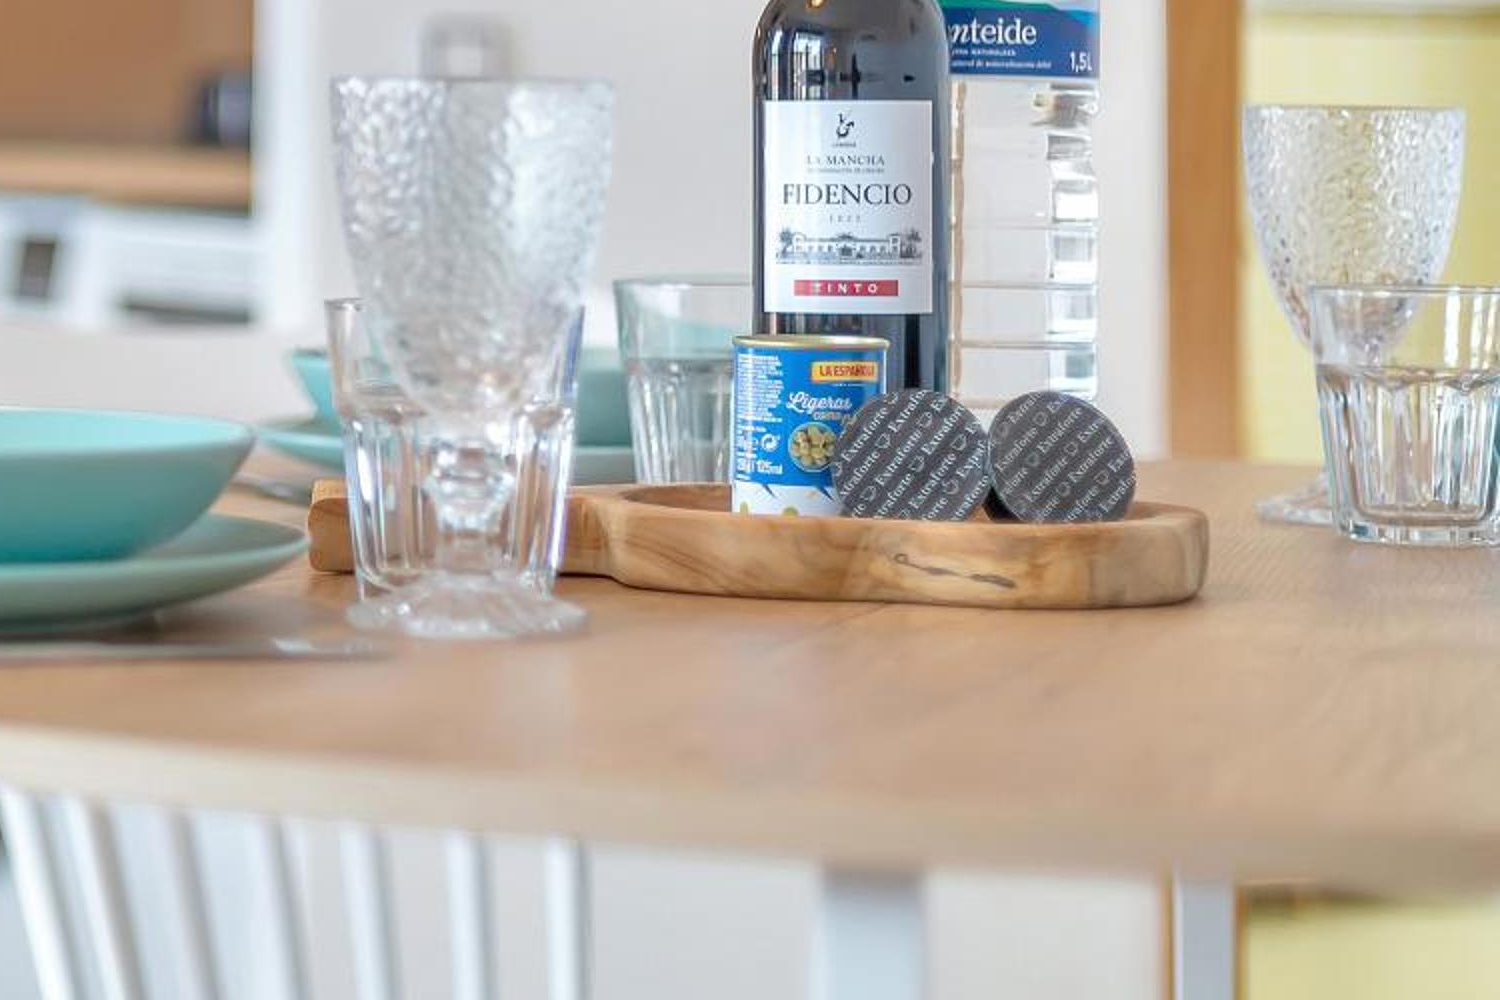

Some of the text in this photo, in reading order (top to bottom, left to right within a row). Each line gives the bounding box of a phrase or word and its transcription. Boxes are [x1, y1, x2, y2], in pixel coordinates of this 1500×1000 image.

[947, 18, 1037, 45] nteide
[826, 154, 885, 166] MANCHA
[782, 183, 912, 205] FIDENCIO
[813, 284, 878, 295] TINTO
[786, 391, 853, 415] Ligeras
[841, 406, 890, 462] Extraforte
[875, 430, 923, 487] Extraforte
[908, 453, 957, 509] Extraforte
